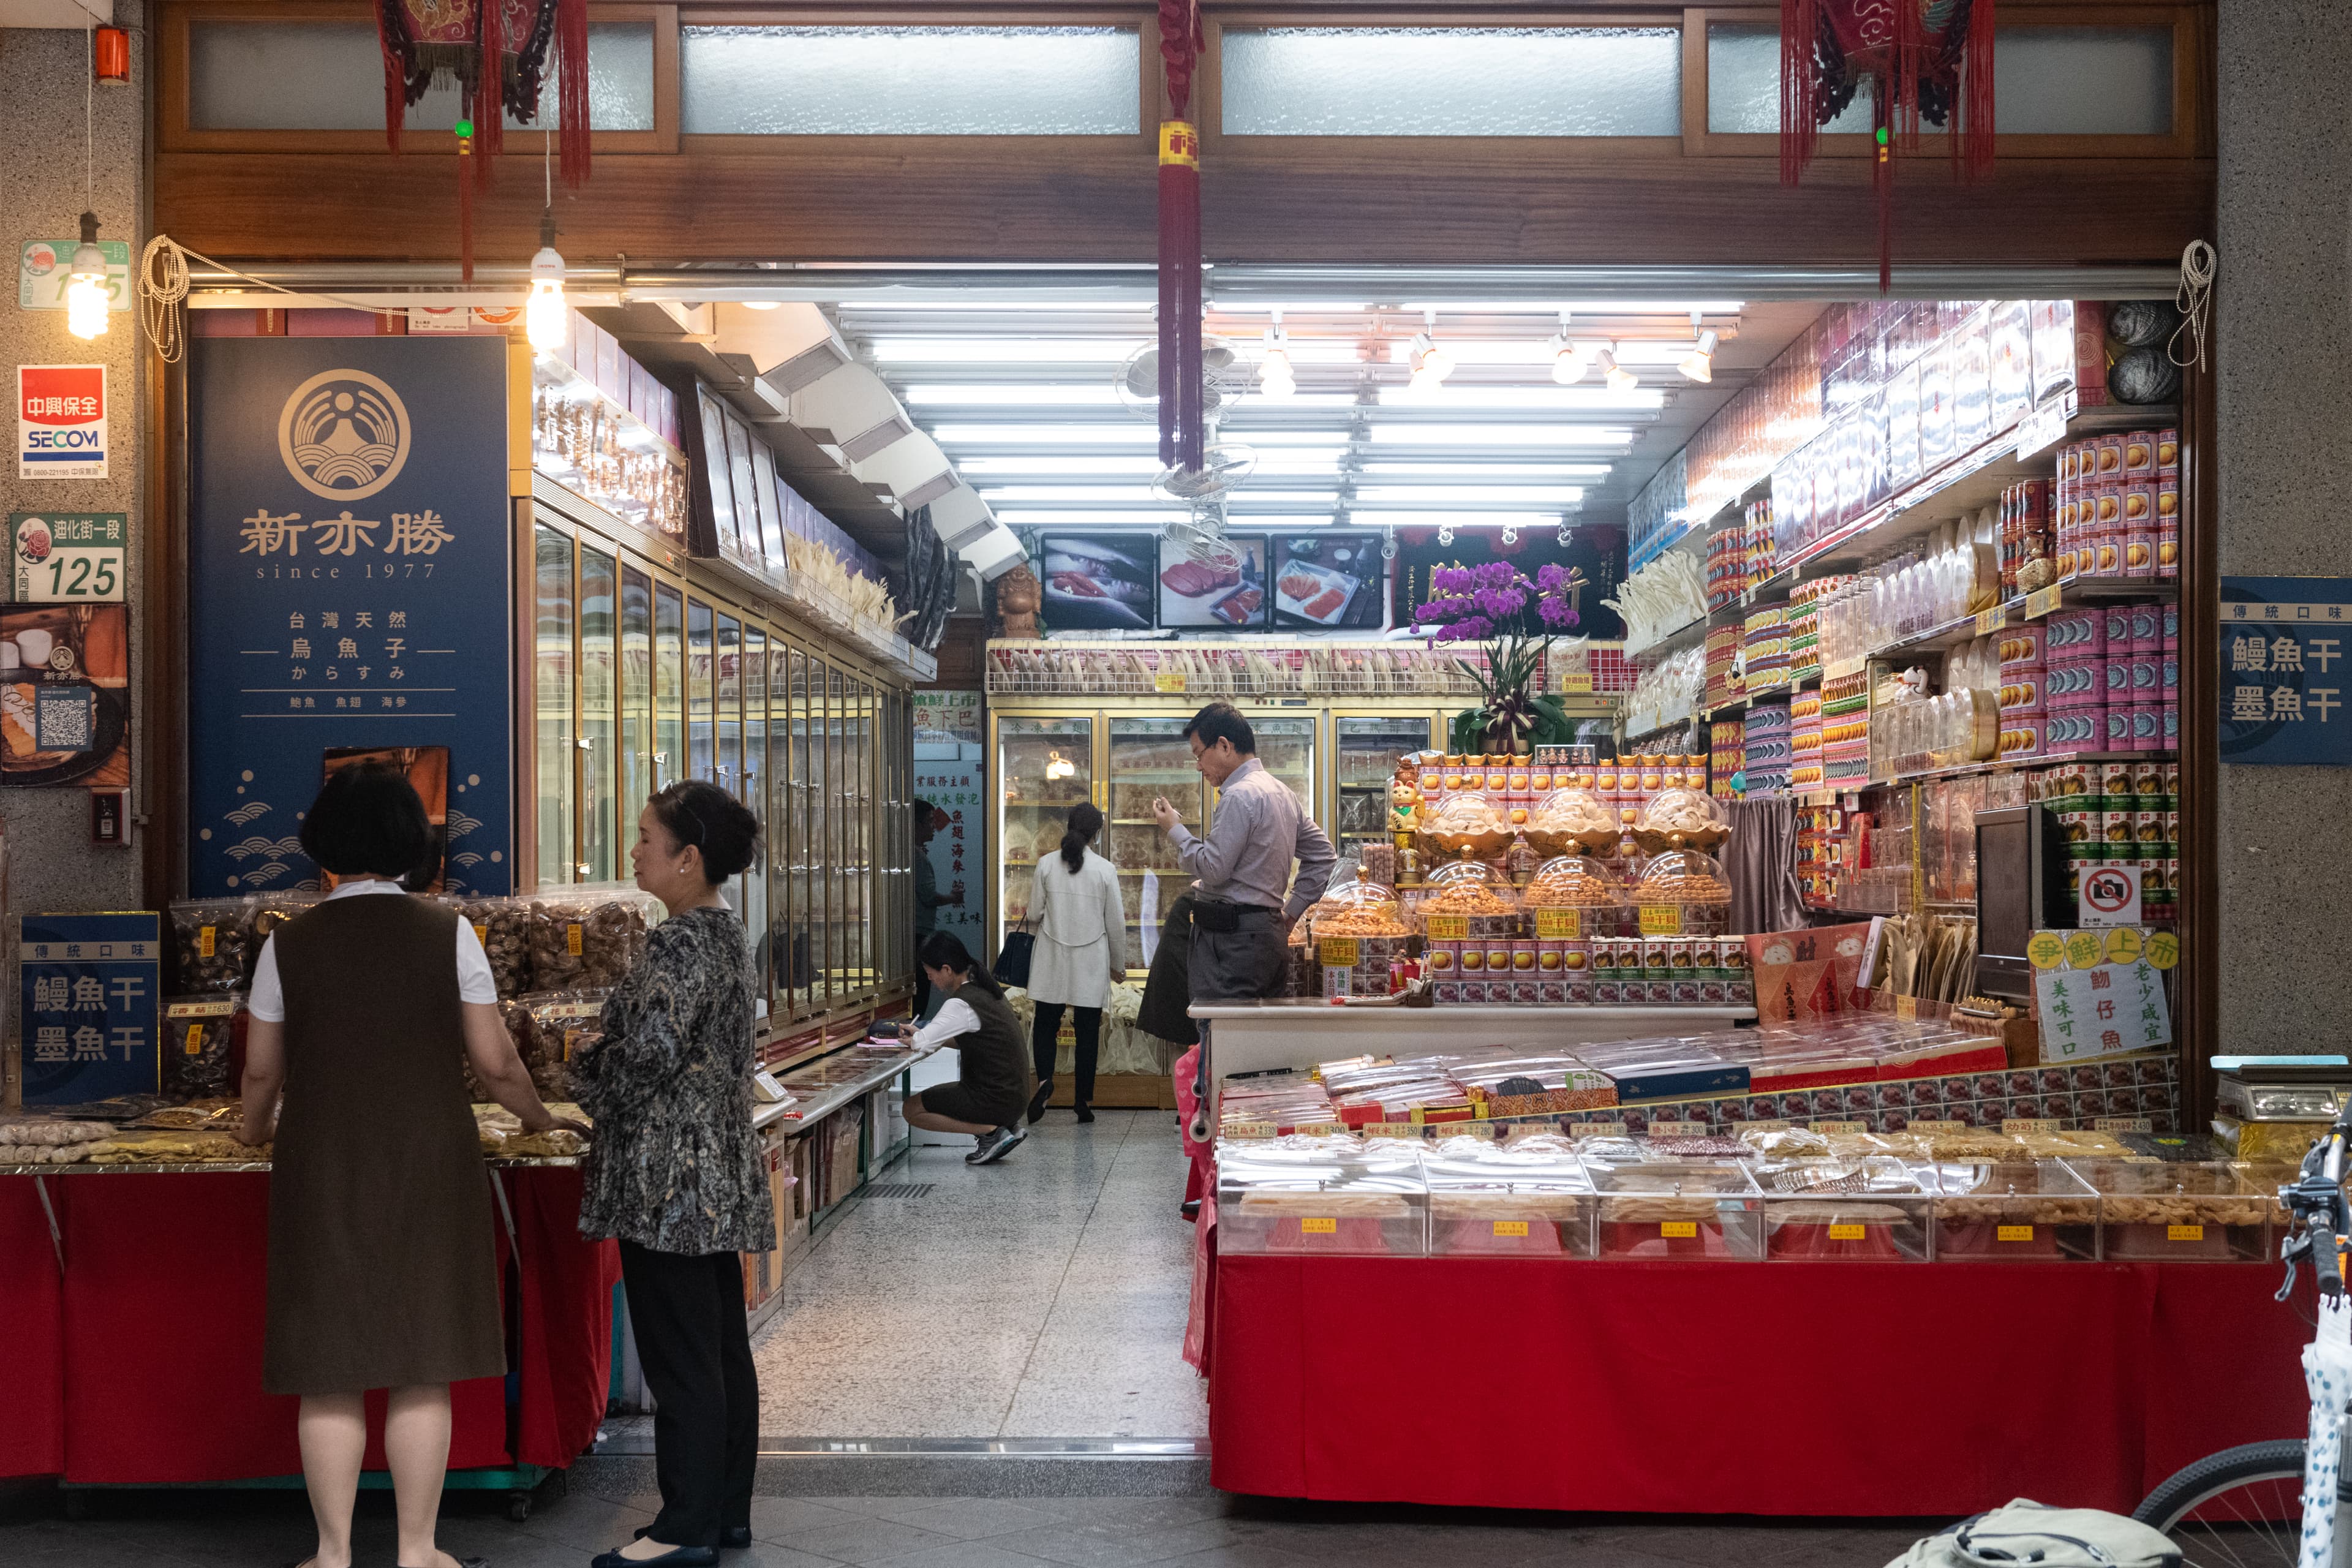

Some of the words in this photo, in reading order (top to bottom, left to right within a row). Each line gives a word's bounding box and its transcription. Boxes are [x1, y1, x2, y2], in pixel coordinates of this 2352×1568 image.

[56, 273, 125, 301] 15
[27, 396, 97, 416] 中興保全
[28, 431, 98, 448] SECOM
[54, 519, 119, 540] 迪化街一段
[239, 510, 455, 556] 新亦勝
[48, 557, 118, 596] 125
[257, 565, 340, 579] since
[366, 564, 435, 579] 1977
[18, 565, 29, 601] 大同區
[290, 611, 407, 629] 台灣天然
[2233, 605, 2342, 620] 傳統口味
[290, 638, 406, 660] 烏魚子
[2231, 636, 2342, 673] 鰻魚干
[292, 666, 405, 680] からすみ
[290, 697, 315, 708] 鮑魚
[336, 697, 361, 708] 魚翅
[382, 696, 407, 708] 海參
[2231, 685, 2342, 722] 墨魚干
[1011, 722, 1084, 734] 冷凍魚翅
[1121, 722, 1186, 733] 冷凍魚
[1444, 925, 1464, 935] 干貝
[1553, 918, 1575, 928] 干貝
[1655, 918, 1676, 928] 干貝
[34, 944, 145, 958] 傳統口味
[1333, 946, 1354, 957] 干貝
[34, 976, 145, 1012] 鰻魚干
[2051, 979, 2077, 1056] 美味可口
[34, 1025, 145, 1062] 墨魚干
[1264, 1126, 1275, 1135] 330
[1367, 1126, 1392, 1135] 蝦米
[1480, 1126, 1491, 1136] 280
